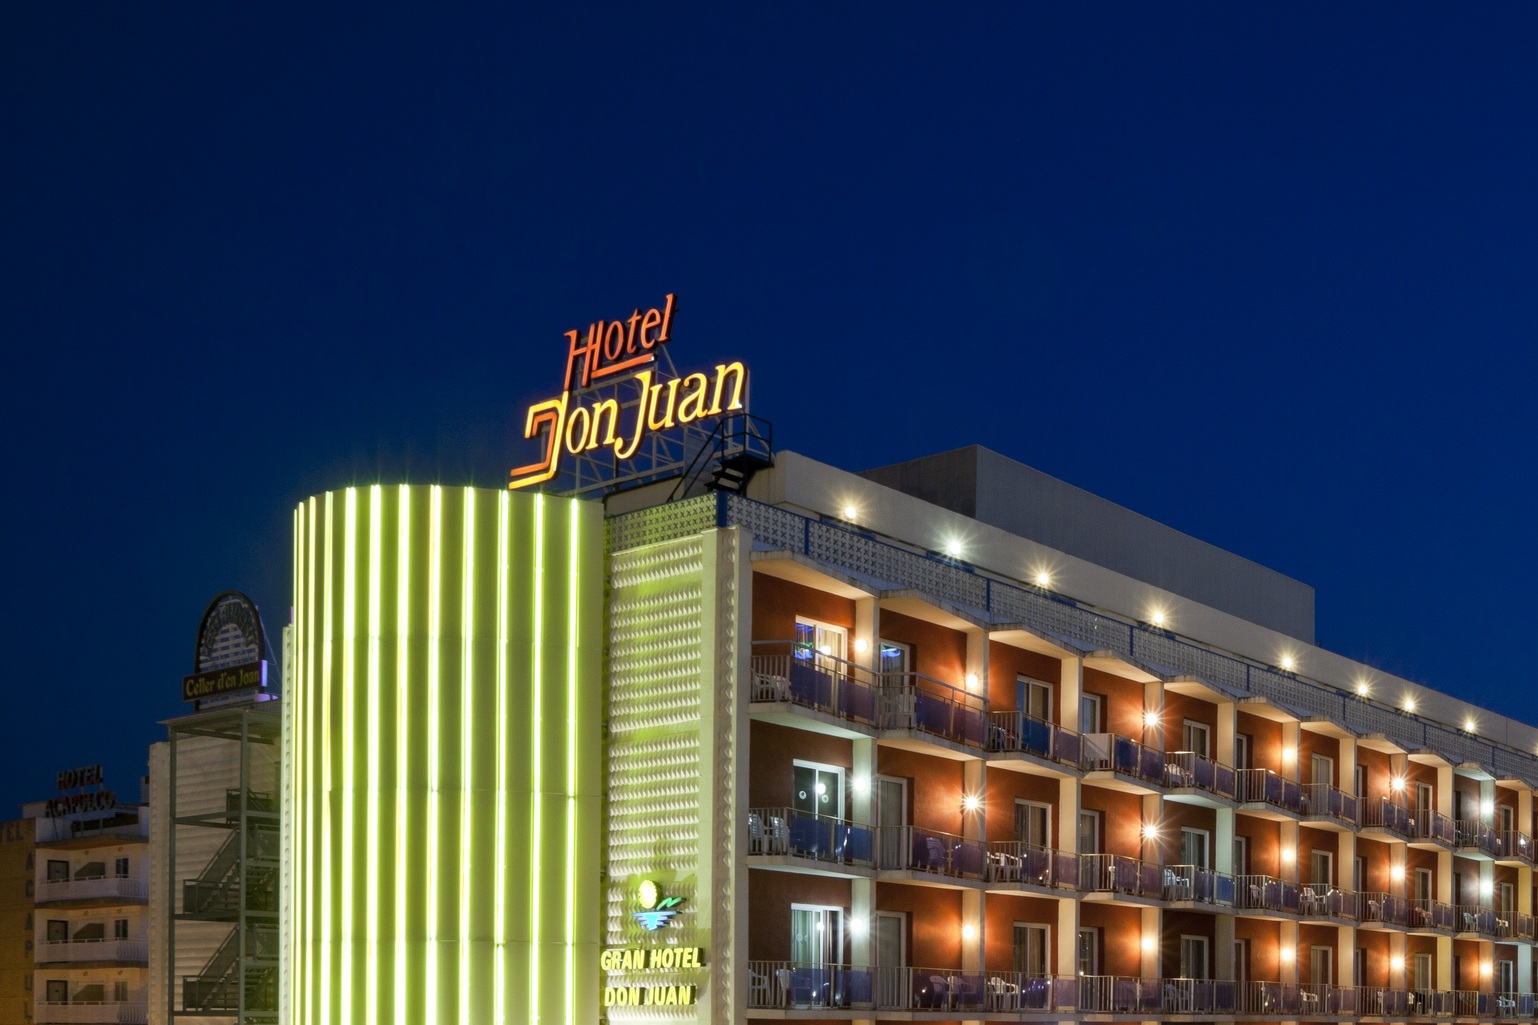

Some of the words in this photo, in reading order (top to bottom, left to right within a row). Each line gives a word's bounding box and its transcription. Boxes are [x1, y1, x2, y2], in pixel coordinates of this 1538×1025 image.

[564, 292, 678, 391] Hotel
[613, 360, 748, 460] Juan
[185, 676, 216, 698] Celler
[239, 668, 260, 687] Joan
[56, 764, 104, 791] HOTEL
[45, 790, 116, 818] ACAPULCO
[600, 948, 646, 971] GRAN
[650, 947, 704, 969] HOTEL
[604, 986, 642, 1007] DON
[645, 985, 693, 1006] JUAN
